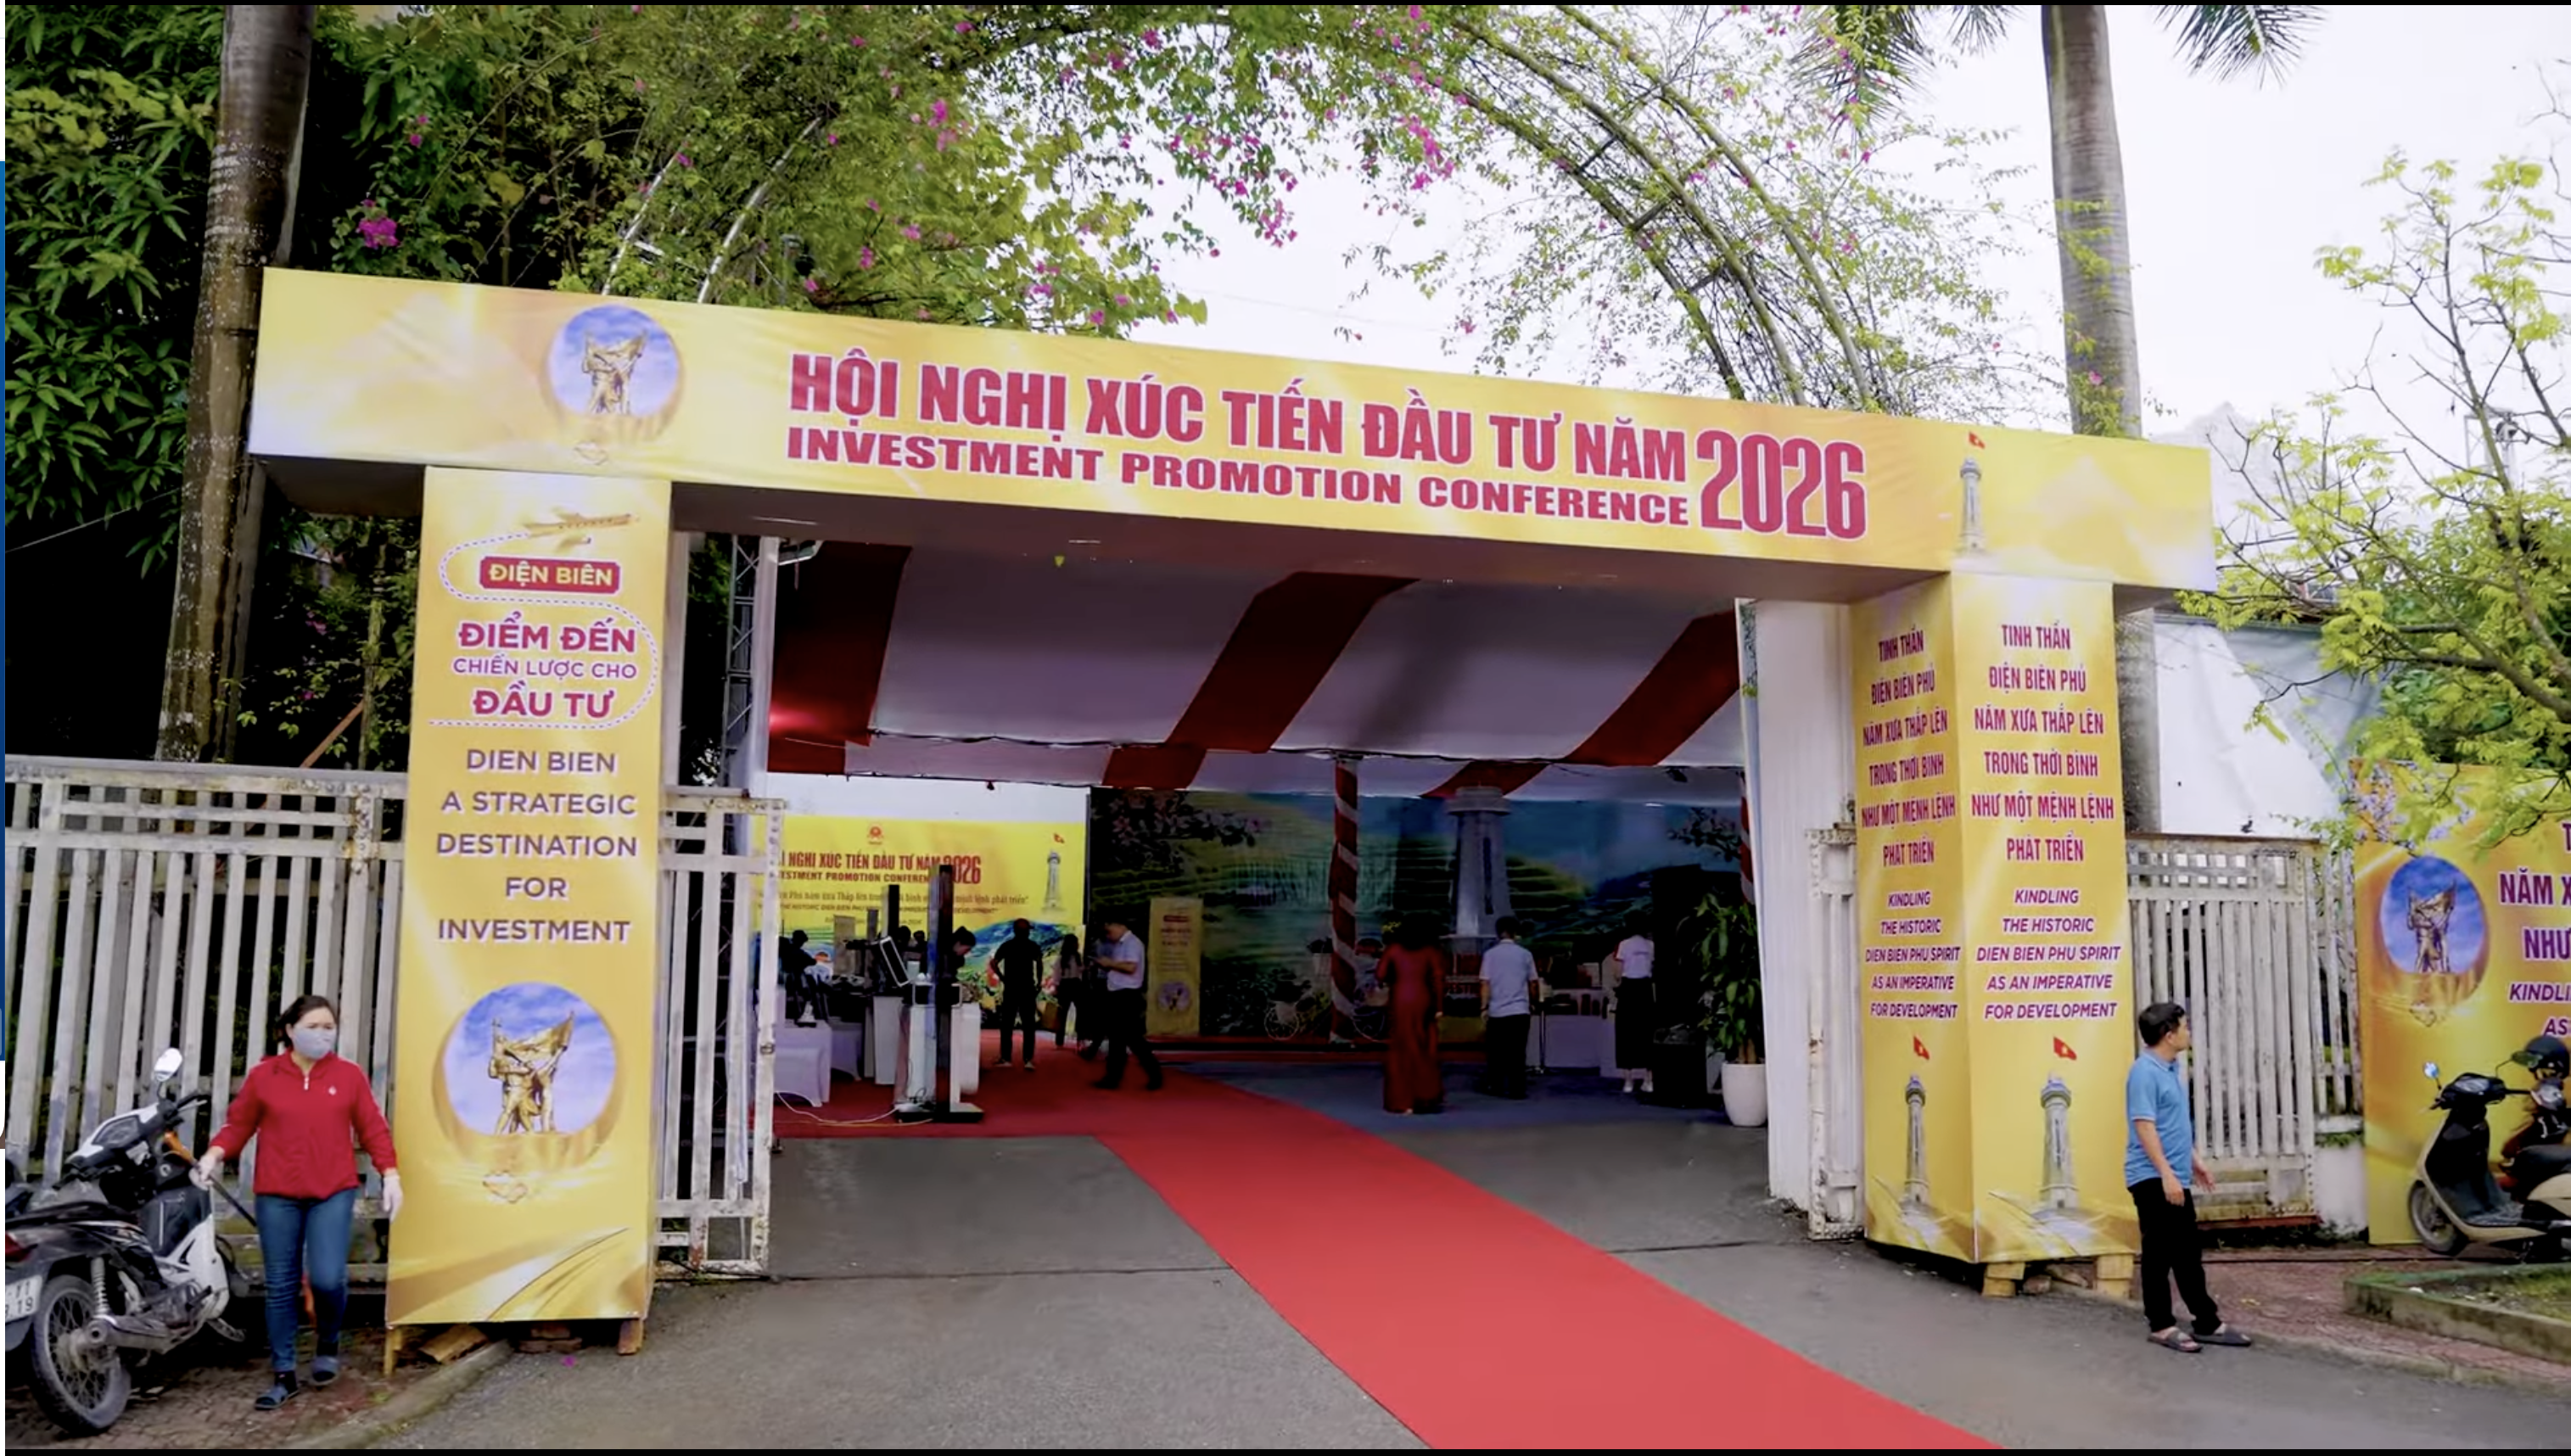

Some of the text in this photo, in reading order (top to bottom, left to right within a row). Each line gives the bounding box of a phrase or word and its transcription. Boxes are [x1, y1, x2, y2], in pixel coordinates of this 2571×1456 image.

[789, 347, 1867, 540] HỘI NGHỊ XÚC TIẾN ĐẦU TƯ NĂM 2026
[787, 426, 1689, 526] INVESTMENT PROMOTION CONFERENCE
[489, 562, 613, 588] ĐIỆN BIÊN
[458, 610, 636, 653] ĐIỂM ĐẾN
[2002, 624, 2032, 647] TINH
[452, 652, 637, 680] CHIẾN LƯỢC CHO
[1989, 661, 2020, 694] ĐIỆN
[2025, 664, 2056, 691] BIÊN
[473, 680, 614, 719] ĐẦU TƯ
[1974, 703, 2104, 735] NĂM XƯA THẮP LÊN
[467, 748, 615, 772] DIEN BIEN
[1984, 748, 2098, 776] TRONG THỜI BÌNH
[1869, 762, 1897, 787] TRONG
[441, 791, 636, 816] A STRATEGIC
[1971, 790, 2114, 824] NHƯ MỘT MỆNH LỆNH
[437, 832, 637, 857] DESTINATION
[2007, 831, 2084, 861] PHÁT TRIỂN
[505, 876, 568, 898] FOR
[884, 873, 930, 883] CONFEREN
[2500, 866, 2553, 905] NĂM
[1888, 891, 1931, 907] KINDLING
[2014, 889, 2079, 904] KINDLING
[439, 918, 631, 942] INVESTMENT
[1881, 919, 1941, 934] THE HISTORIC
[2002, 918, 2094, 932] THE HISTORIC
[1866, 946, 1961, 962] DIEN BIEN PHU SPIRIT
[1976, 946, 2121, 961] DIEN BIEN PHU SPIRIT
[1872, 976, 1954, 990] AS AN IMPERATIVE
[1986, 974, 2113, 990] AS AN IMPERATIVE
[1871, 1003, 1958, 1018] FOR DEVELOPMENT
[1985, 1002, 2118, 1019] FOR DEVELOPMENT
[2543, 1018, 2568, 1035] AS
